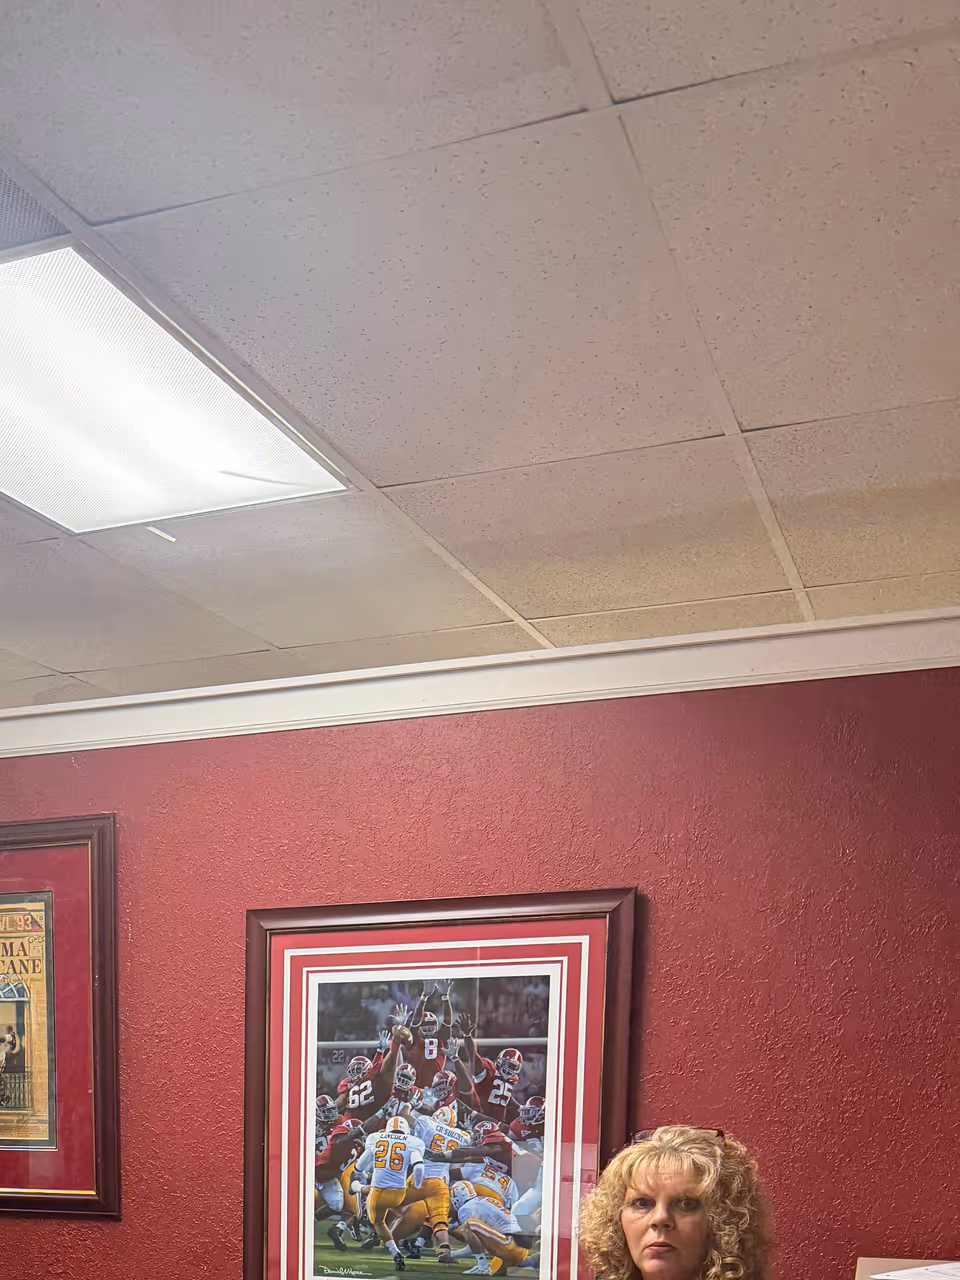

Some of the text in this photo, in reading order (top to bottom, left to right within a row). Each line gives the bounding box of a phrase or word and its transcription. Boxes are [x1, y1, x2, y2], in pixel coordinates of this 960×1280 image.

[14, 912, 32, 931] '93
[424, 1038, 439, 1060] 8
[348, 1079, 375, 1109] 62
[488, 1078, 514, 1108] 25
[374, 1139, 406, 1171] 26
